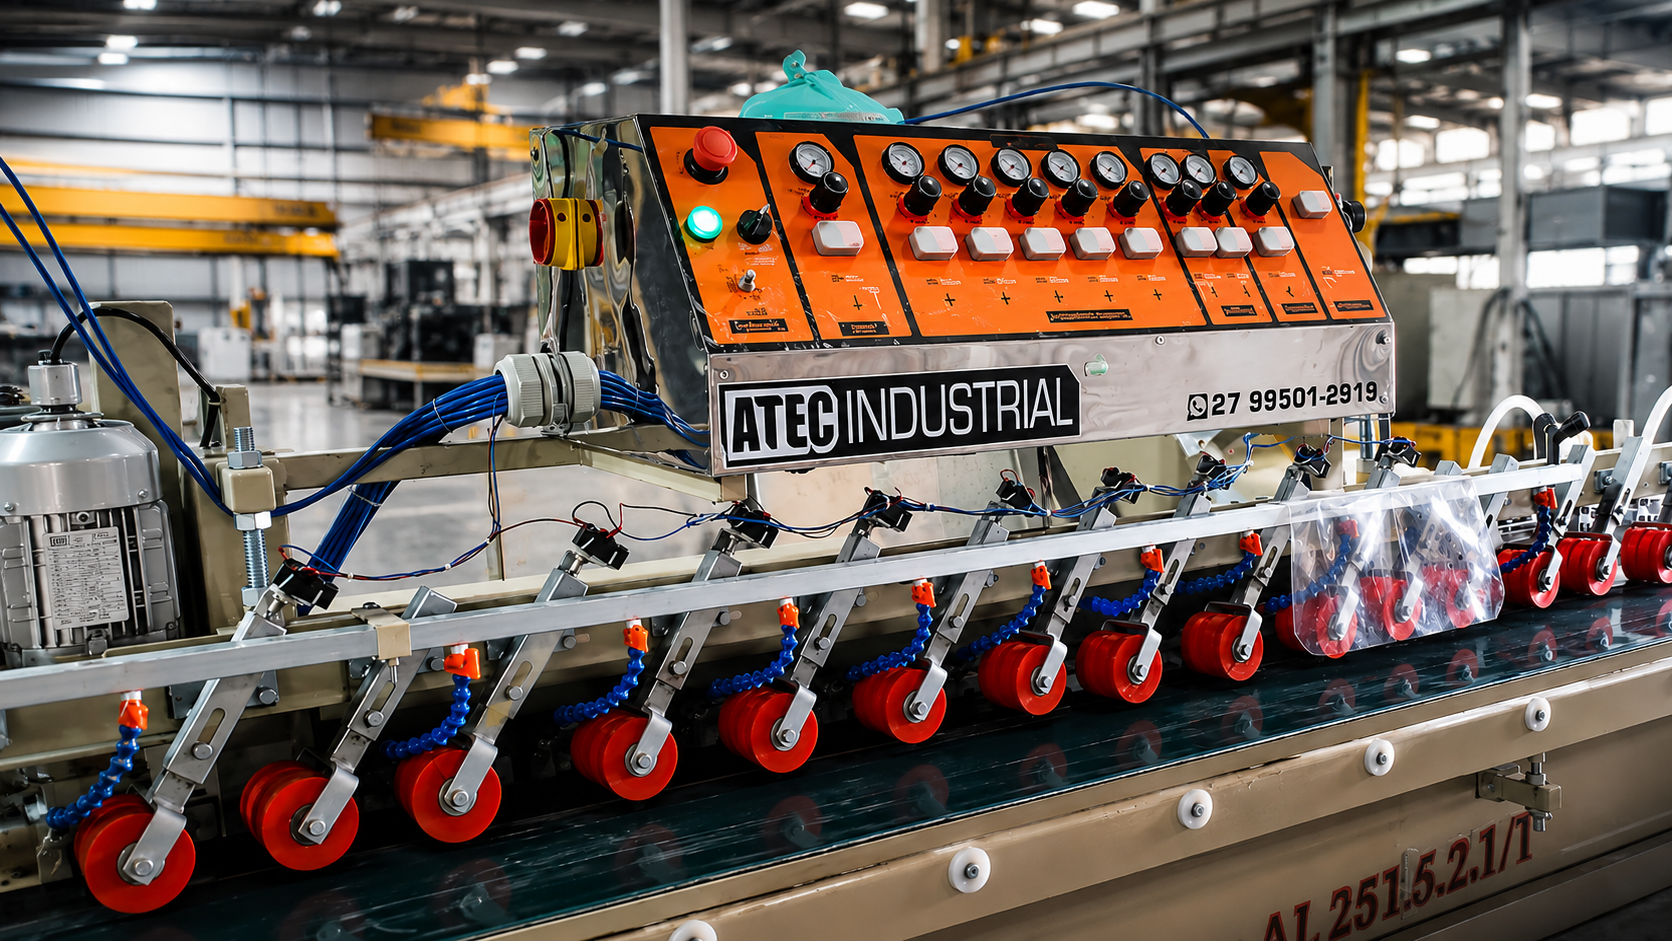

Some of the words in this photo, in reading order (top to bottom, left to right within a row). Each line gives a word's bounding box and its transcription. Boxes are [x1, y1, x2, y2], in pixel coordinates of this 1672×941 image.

[731, 389, 836, 453] ATEC
[846, 377, 1074, 444] INDUSTRIAL
[1211, 391, 1241, 417] 27
[1249, 380, 1378, 413] 99501-2919
